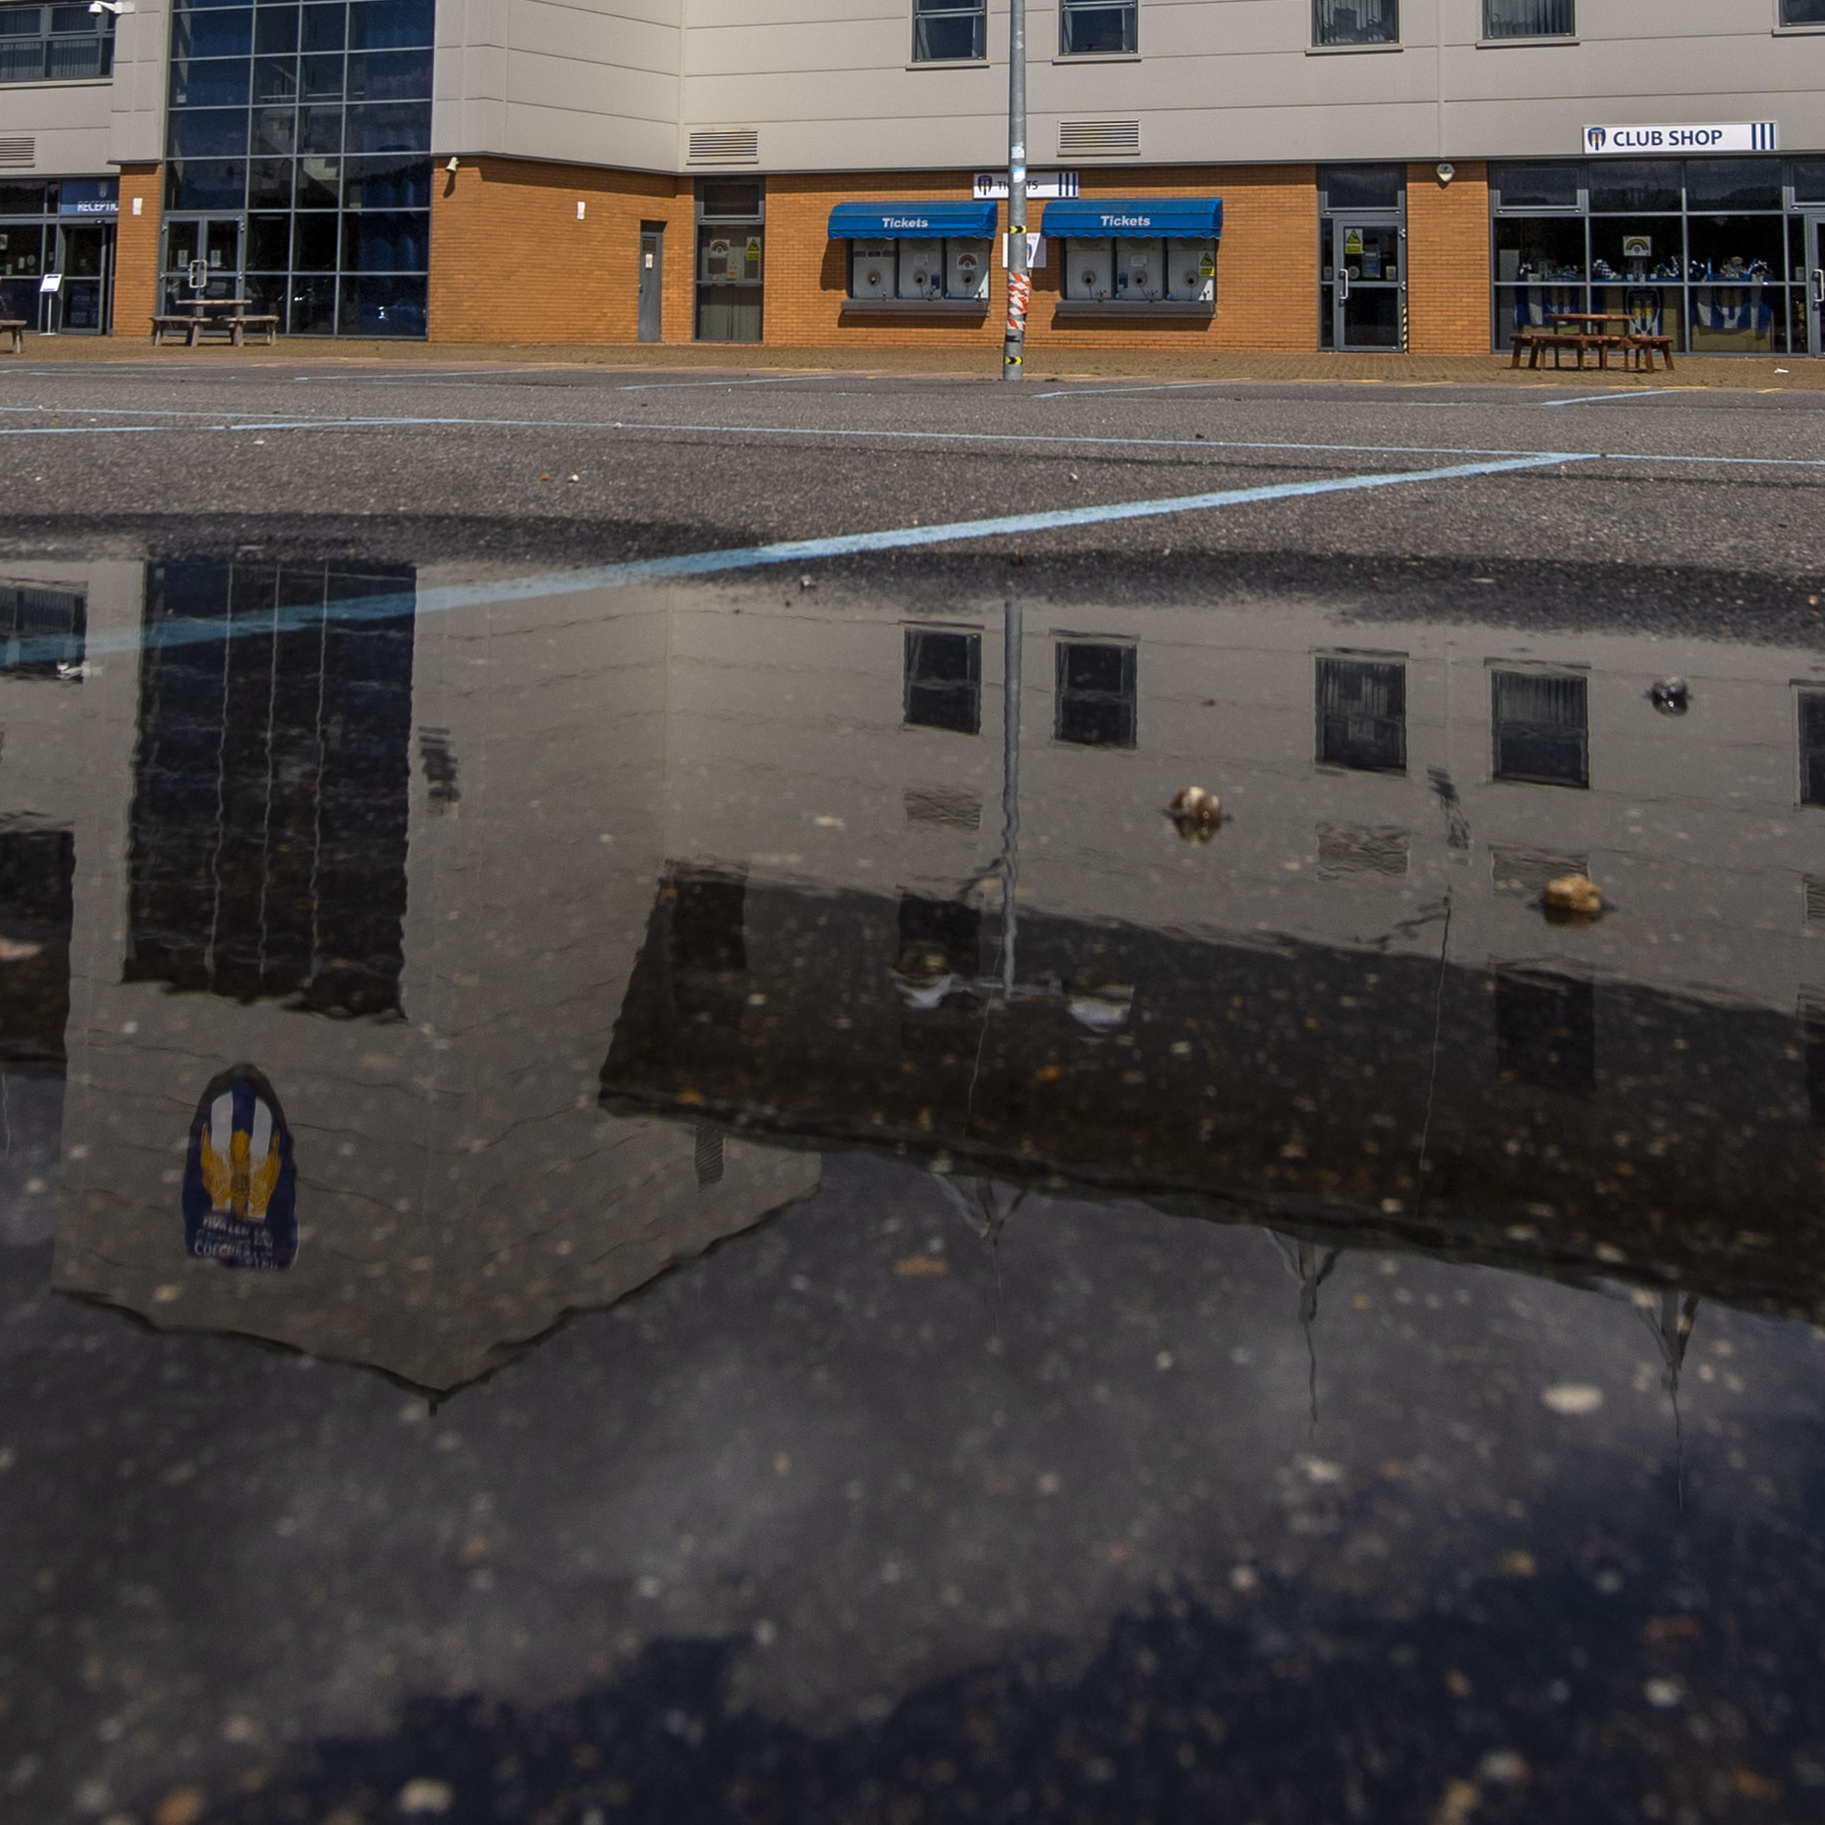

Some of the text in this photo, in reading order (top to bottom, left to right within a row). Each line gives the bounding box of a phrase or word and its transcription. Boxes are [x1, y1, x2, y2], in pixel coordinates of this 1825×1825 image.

[1613, 130, 1723, 147] CLUB SHOP
[998, 180, 1039, 191] TITS
[77, 200, 119, 212] RECEPTIO
[882, 217, 929, 229] Tickets
[1100, 215, 1151, 227] Tickets
